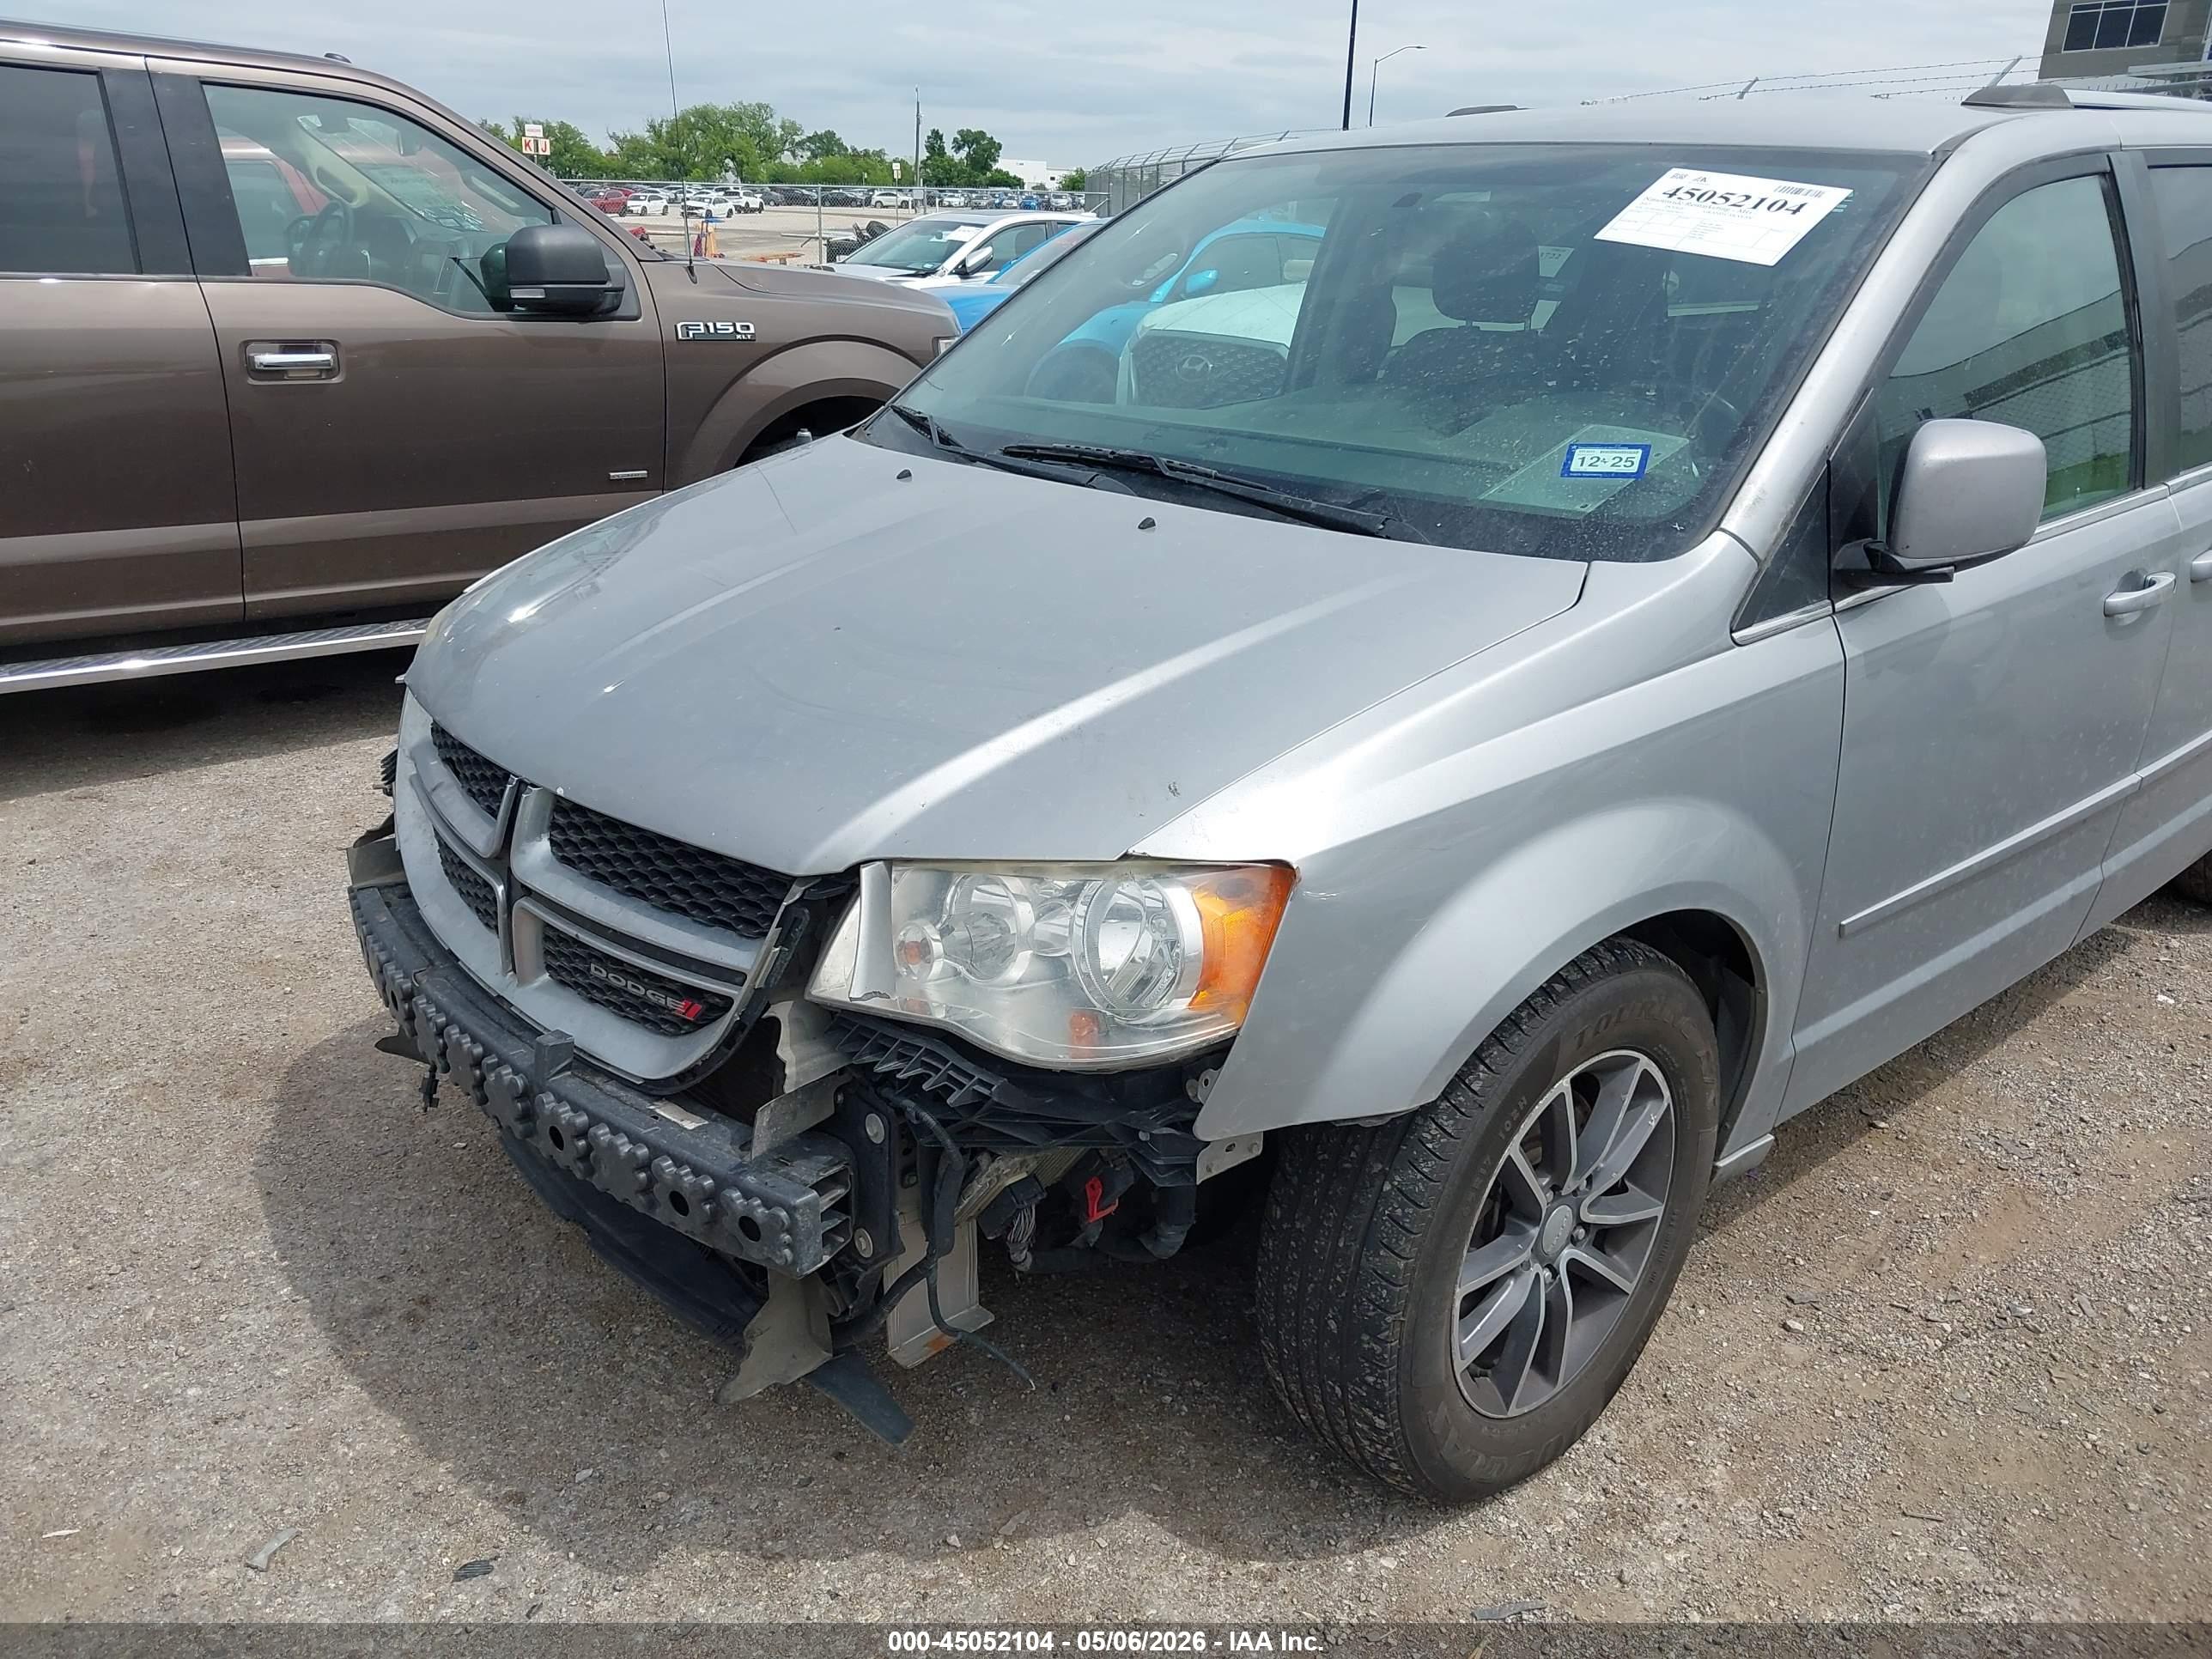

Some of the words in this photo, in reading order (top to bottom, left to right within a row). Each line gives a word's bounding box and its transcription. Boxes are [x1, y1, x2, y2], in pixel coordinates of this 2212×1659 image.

[524, 139, 532, 151] K
[541, 141, 547, 153] J
[1662, 185, 1808, 216] 45052104
[675, 321, 756, 341] F150
[1577, 456, 1601, 467] 12
[1609, 456, 1636, 468] 25
[591, 962, 685, 1013] DODGE
